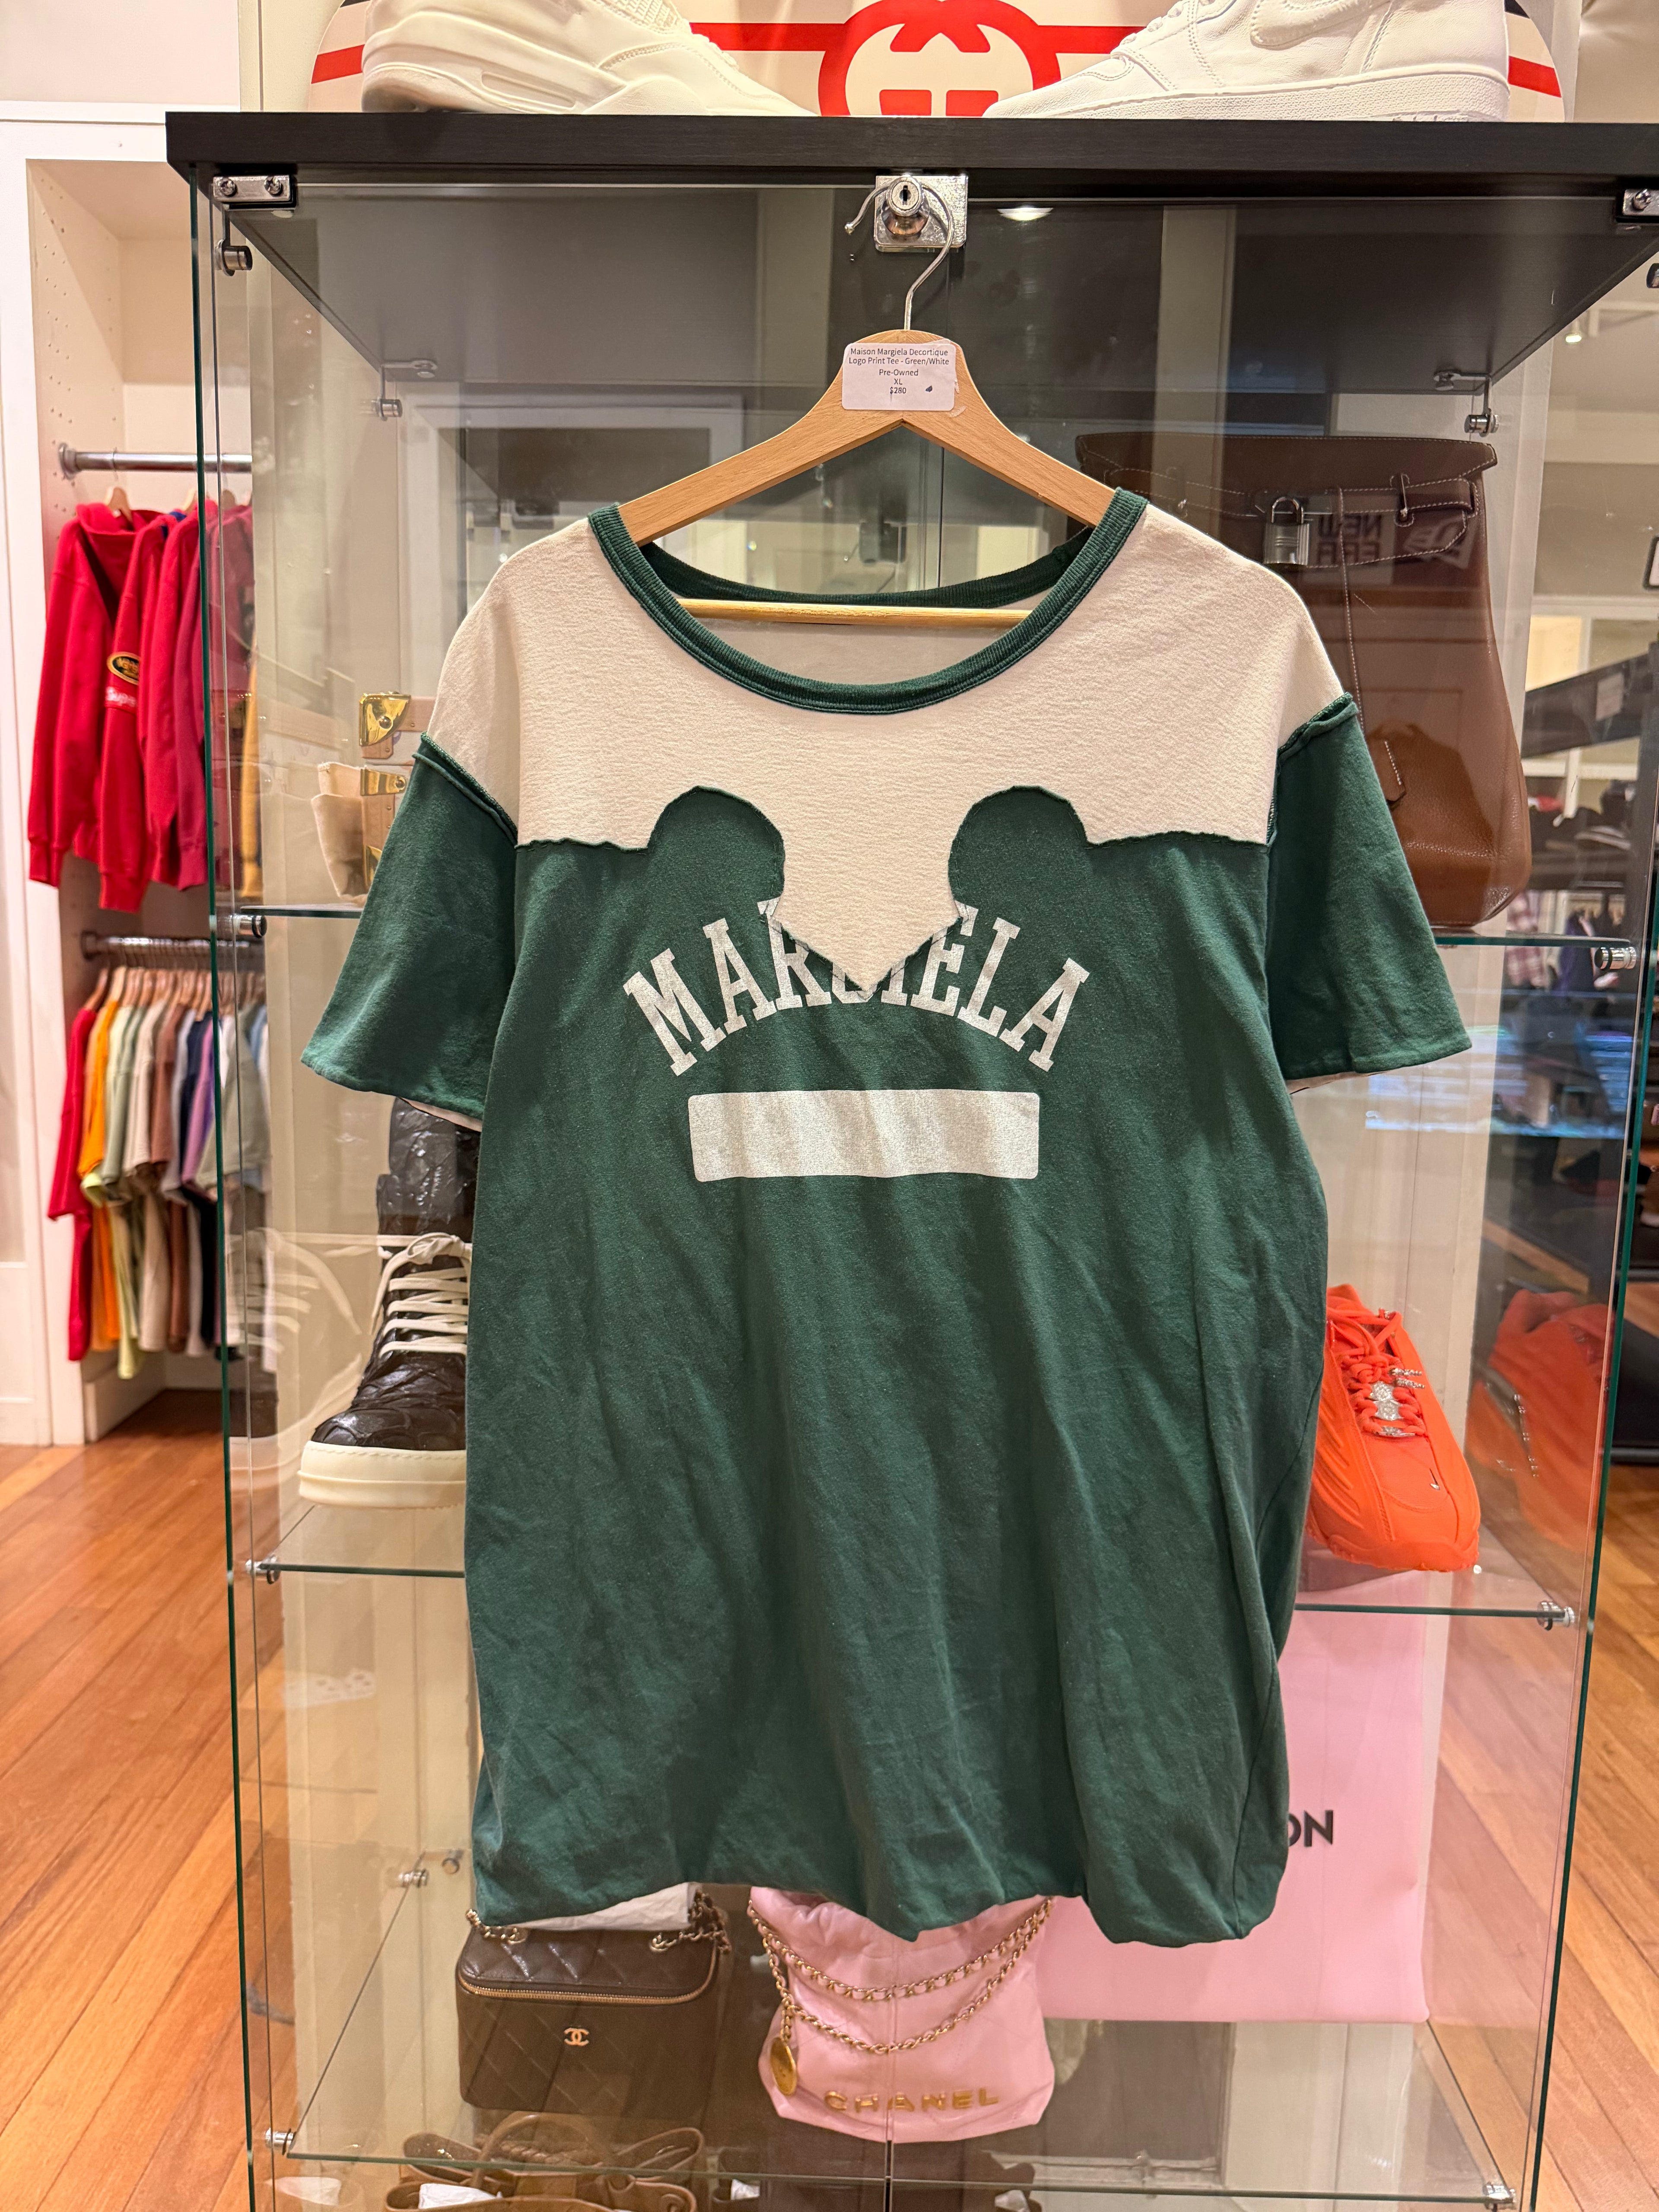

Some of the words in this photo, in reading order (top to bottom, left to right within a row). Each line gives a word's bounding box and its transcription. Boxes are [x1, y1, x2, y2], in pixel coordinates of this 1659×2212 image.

[877, 348, 907, 357] Margiela
[909, 348, 948, 357] Decortique
[849, 357, 866, 366] Logo
[905, 357, 949, 366] Green/White
[824, 2087, 999, 2113] CHANEL
